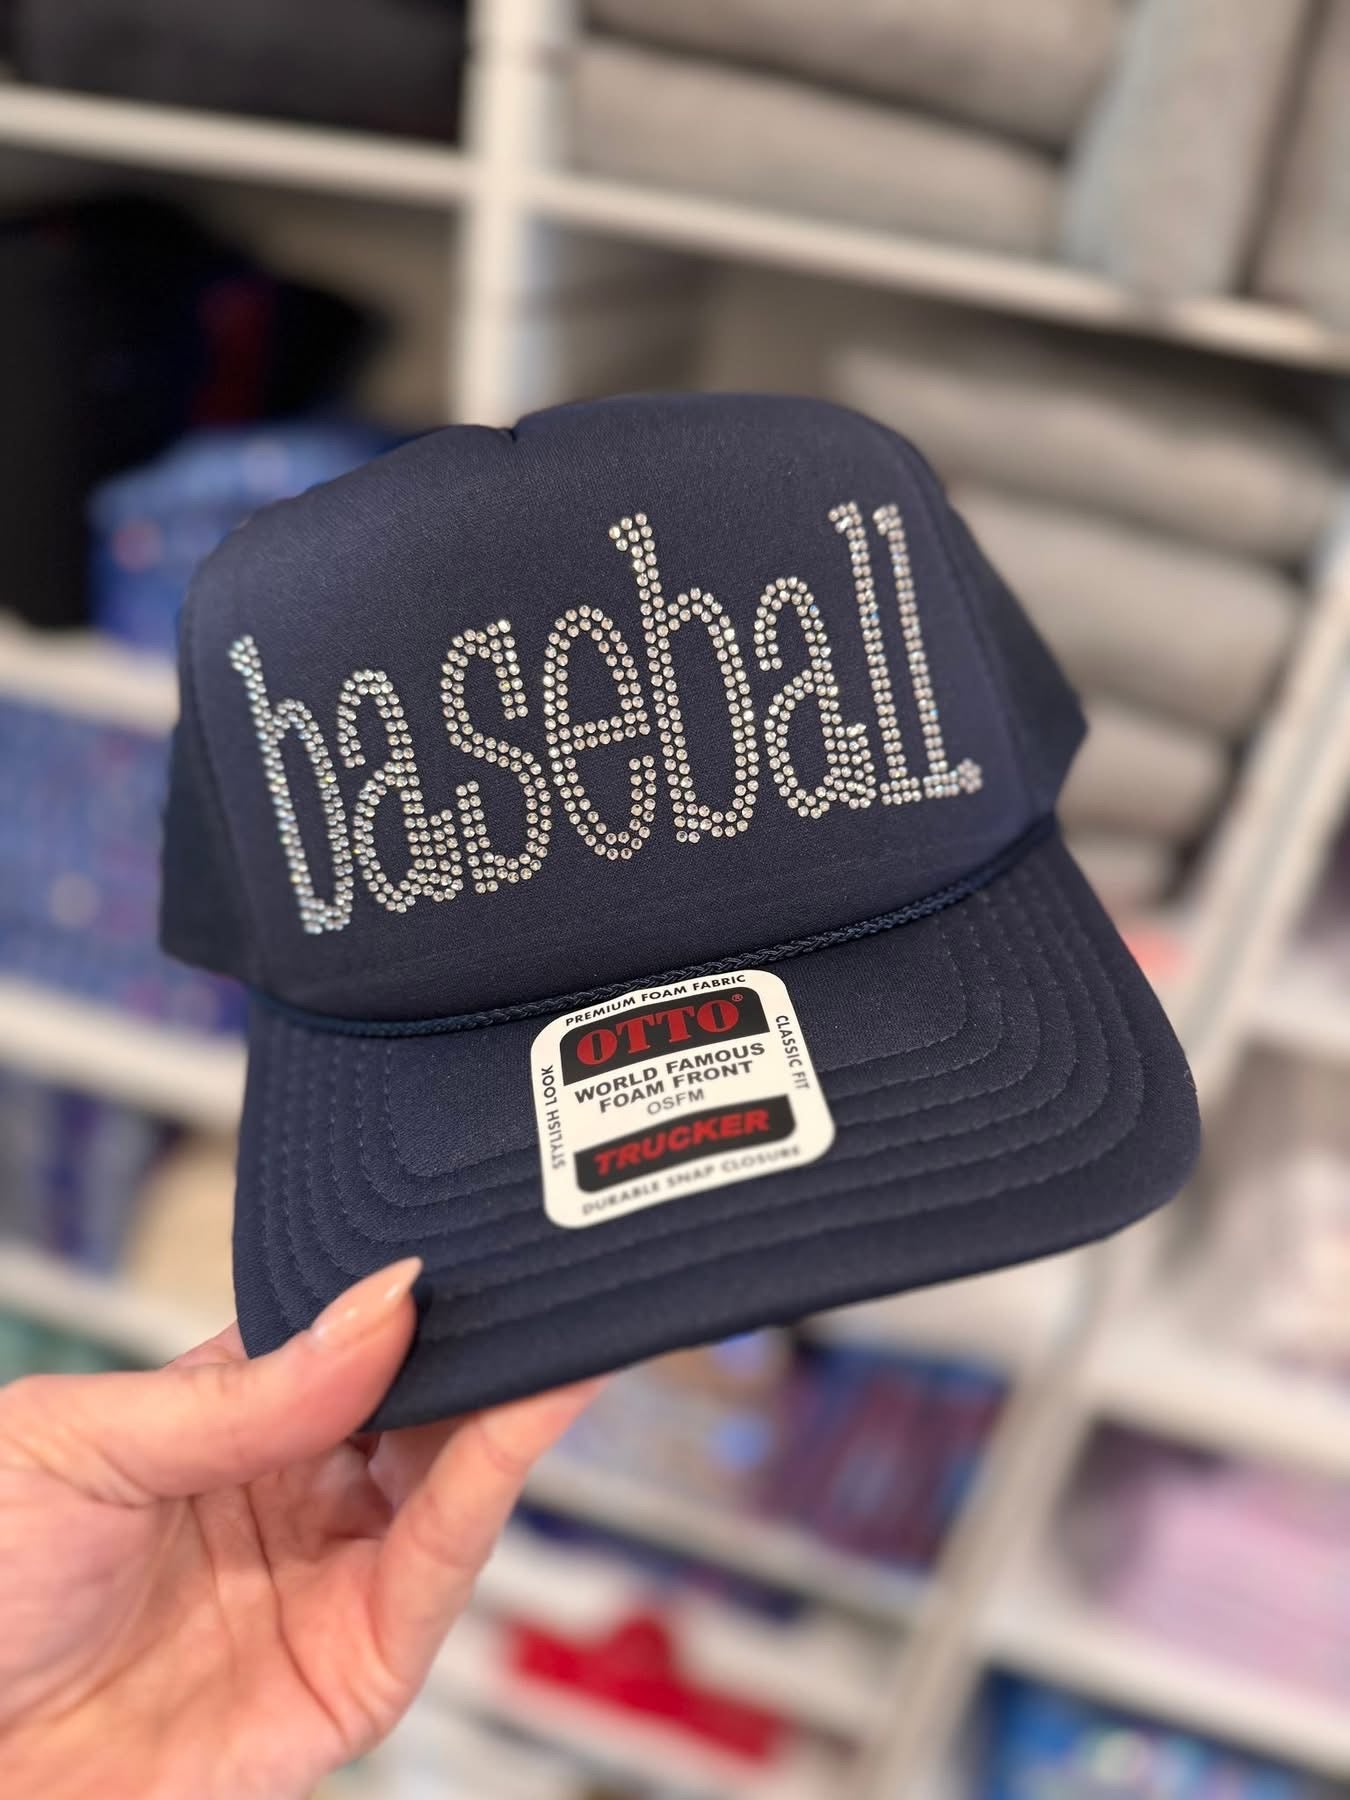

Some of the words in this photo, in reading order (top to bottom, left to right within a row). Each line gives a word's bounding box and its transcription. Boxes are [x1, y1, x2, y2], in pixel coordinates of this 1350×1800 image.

[228, 501, 984, 935] baseball
[566, 997, 636, 1026] PREMIUM
[641, 985, 687, 1002] FOAM
[693, 974, 746, 990] FABRIC
[575, 1066, 658, 1103] WORLD
[667, 1042, 765, 1074] FAMOUS
[776, 1015, 803, 1068] CLASSIC
[792, 1071, 810, 1090] FIT
[541, 1064, 557, 1106] LOOK
[600, 1081, 665, 1113] FOAM
[674, 1060, 753, 1088] FRONT
[646, 1089, 705, 1115] OSFM
[546, 1109, 566, 1169] STYLISH
[593, 1109, 769, 1176] TRUCKER
[582, 1181, 661, 1215] DURABLE
[666, 1164, 715, 1187] SNAP
[721, 1145, 801, 1173] CLOSURE
